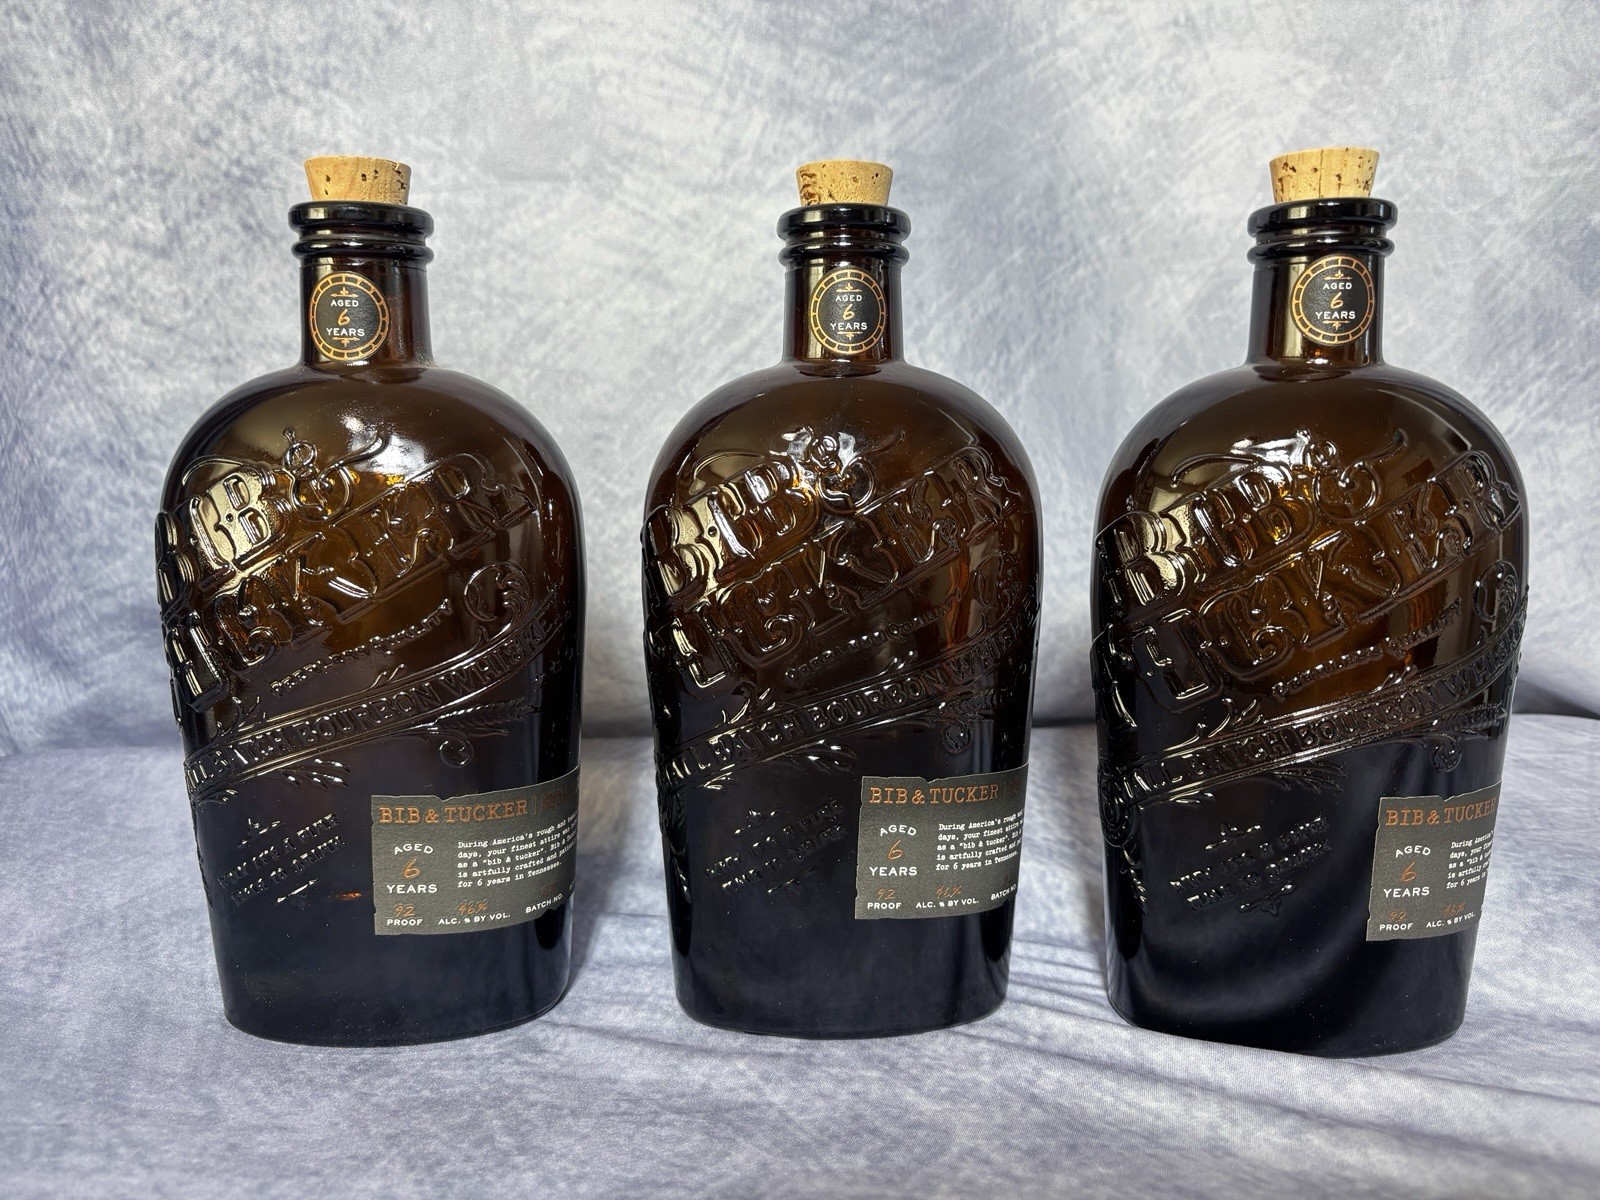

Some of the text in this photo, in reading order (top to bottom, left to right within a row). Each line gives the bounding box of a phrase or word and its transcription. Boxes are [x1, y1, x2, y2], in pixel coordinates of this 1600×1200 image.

[1330, 291, 1344, 309] 6
[338, 308, 351, 326] 6
[842, 303, 855, 320] 6
[1315, 311, 1356, 320] YEARS
[326, 328, 365, 337] YEARS
[830, 322, 868, 330] YEARS
[806, 670, 949, 735] BOURBON
[293, 680, 443, 747] BOURBON
[1292, 683, 1443, 753] BOURBON
[869, 787, 909, 805] BIB
[911, 788, 926, 805] &
[929, 784, 999, 805] TUCKER
[379, 799, 528, 824] BIB & TUCKER
[1385, 809, 1424, 826] BIB
[1427, 810, 1440, 825] &
[880, 824, 917, 837] AGED
[938, 823, 966, 832] During
[968, 818, 1002, 830] America's
[458, 840, 489, 849] During
[492, 831, 533, 846] America's
[536, 825, 556, 837] rough
[938, 833, 959, 841] days,
[963, 831, 980, 841] your
[983, 827, 1004, 837] finest
[394, 843, 434, 855] AGED
[457, 850, 483, 859] days,
[487, 848, 507, 857] your
[511, 842, 538, 853] finest
[540, 834, 561, 846] attire
[887, 840, 904, 860] 6
[1395, 845, 1431, 858] AGED
[1451, 839, 1473, 849] During
[950, 850, 983, 861] artfully
[985, 845, 1008, 856] crafted
[1470, 847, 1482, 857] your
[402, 857, 421, 880] 6
[457, 870, 469, 878] is
[472, 866, 511, 878] artfully
[515, 858, 544, 871] crafted
[547, 852, 557, 862] and
[869, 866, 918, 877] YEARS
[953, 862, 958, 870] 6
[961, 861, 982, 871] years
[1401, 861, 1417, 883] 6
[1447, 871, 1456, 879] is
[1458, 864, 1482, 878] artfully
[457, 880, 474, 888] for
[477, 878, 483, 887] 6
[486, 876, 511, 887] years
[515, 873, 525, 881] in
[1446, 881, 1459, 890] for
[1467, 876, 1481, 887] years
[387, 884, 438, 894] YEARS
[877, 887, 896, 901] 92
[1383, 886, 1430, 898] YEARS
[946, 900, 960, 908] BY
[961, 897, 980, 906] VOL.
[990, 888, 1010, 901] BATCH
[438, 918, 461, 926] ALC.
[473, 915, 487, 923] BY
[489, 913, 511, 922] VOL.
[525, 900, 552, 914] BATCH
[1379, 922, 1414, 931] PROOF
[1426, 920, 1445, 928] ALC.
[1454, 916, 1464, 924] BY
